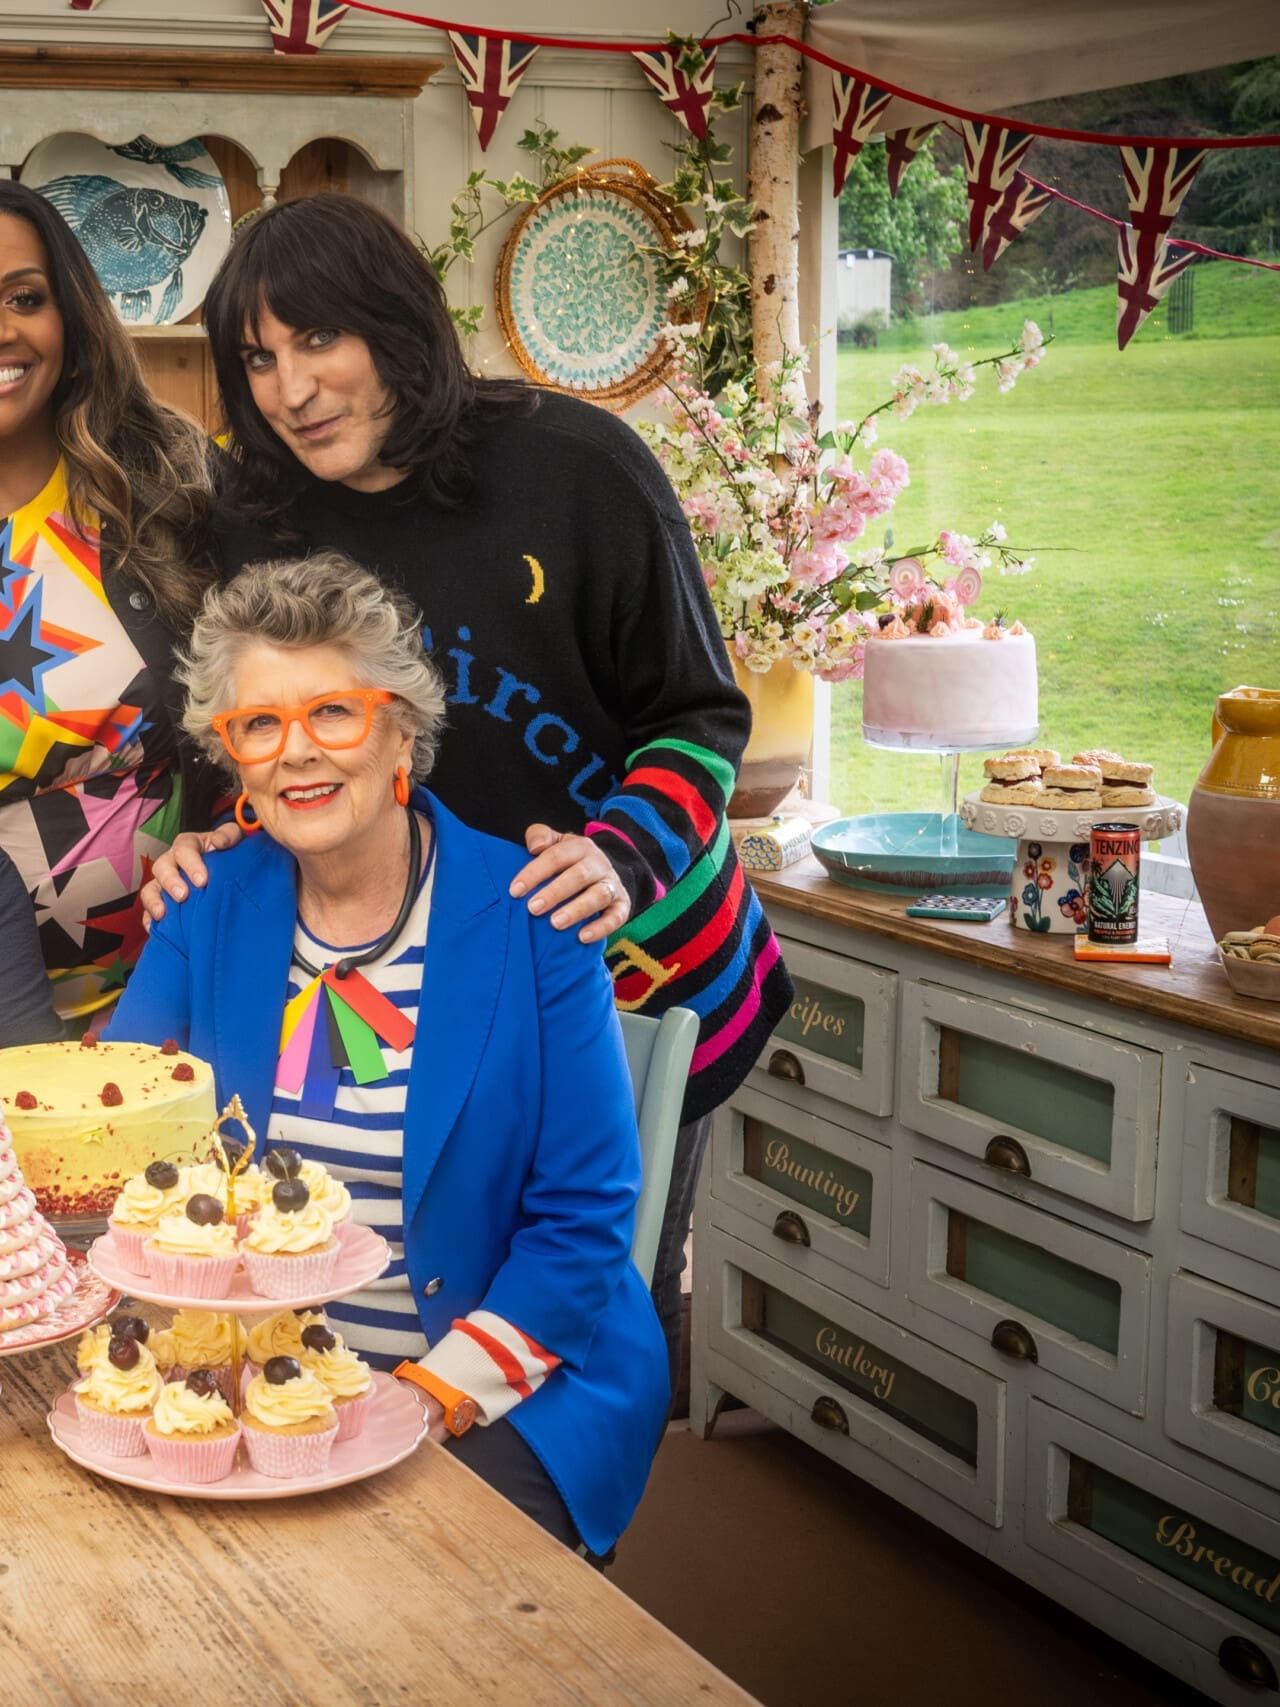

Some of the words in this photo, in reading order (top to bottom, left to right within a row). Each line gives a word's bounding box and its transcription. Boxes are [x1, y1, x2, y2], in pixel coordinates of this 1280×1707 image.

[423, 624, 624, 819] ircu
[764, 1139, 860, 1217] Bunting
[815, 1327, 896, 1400] Cutlery
[1155, 1515, 1280, 1602] Bread
